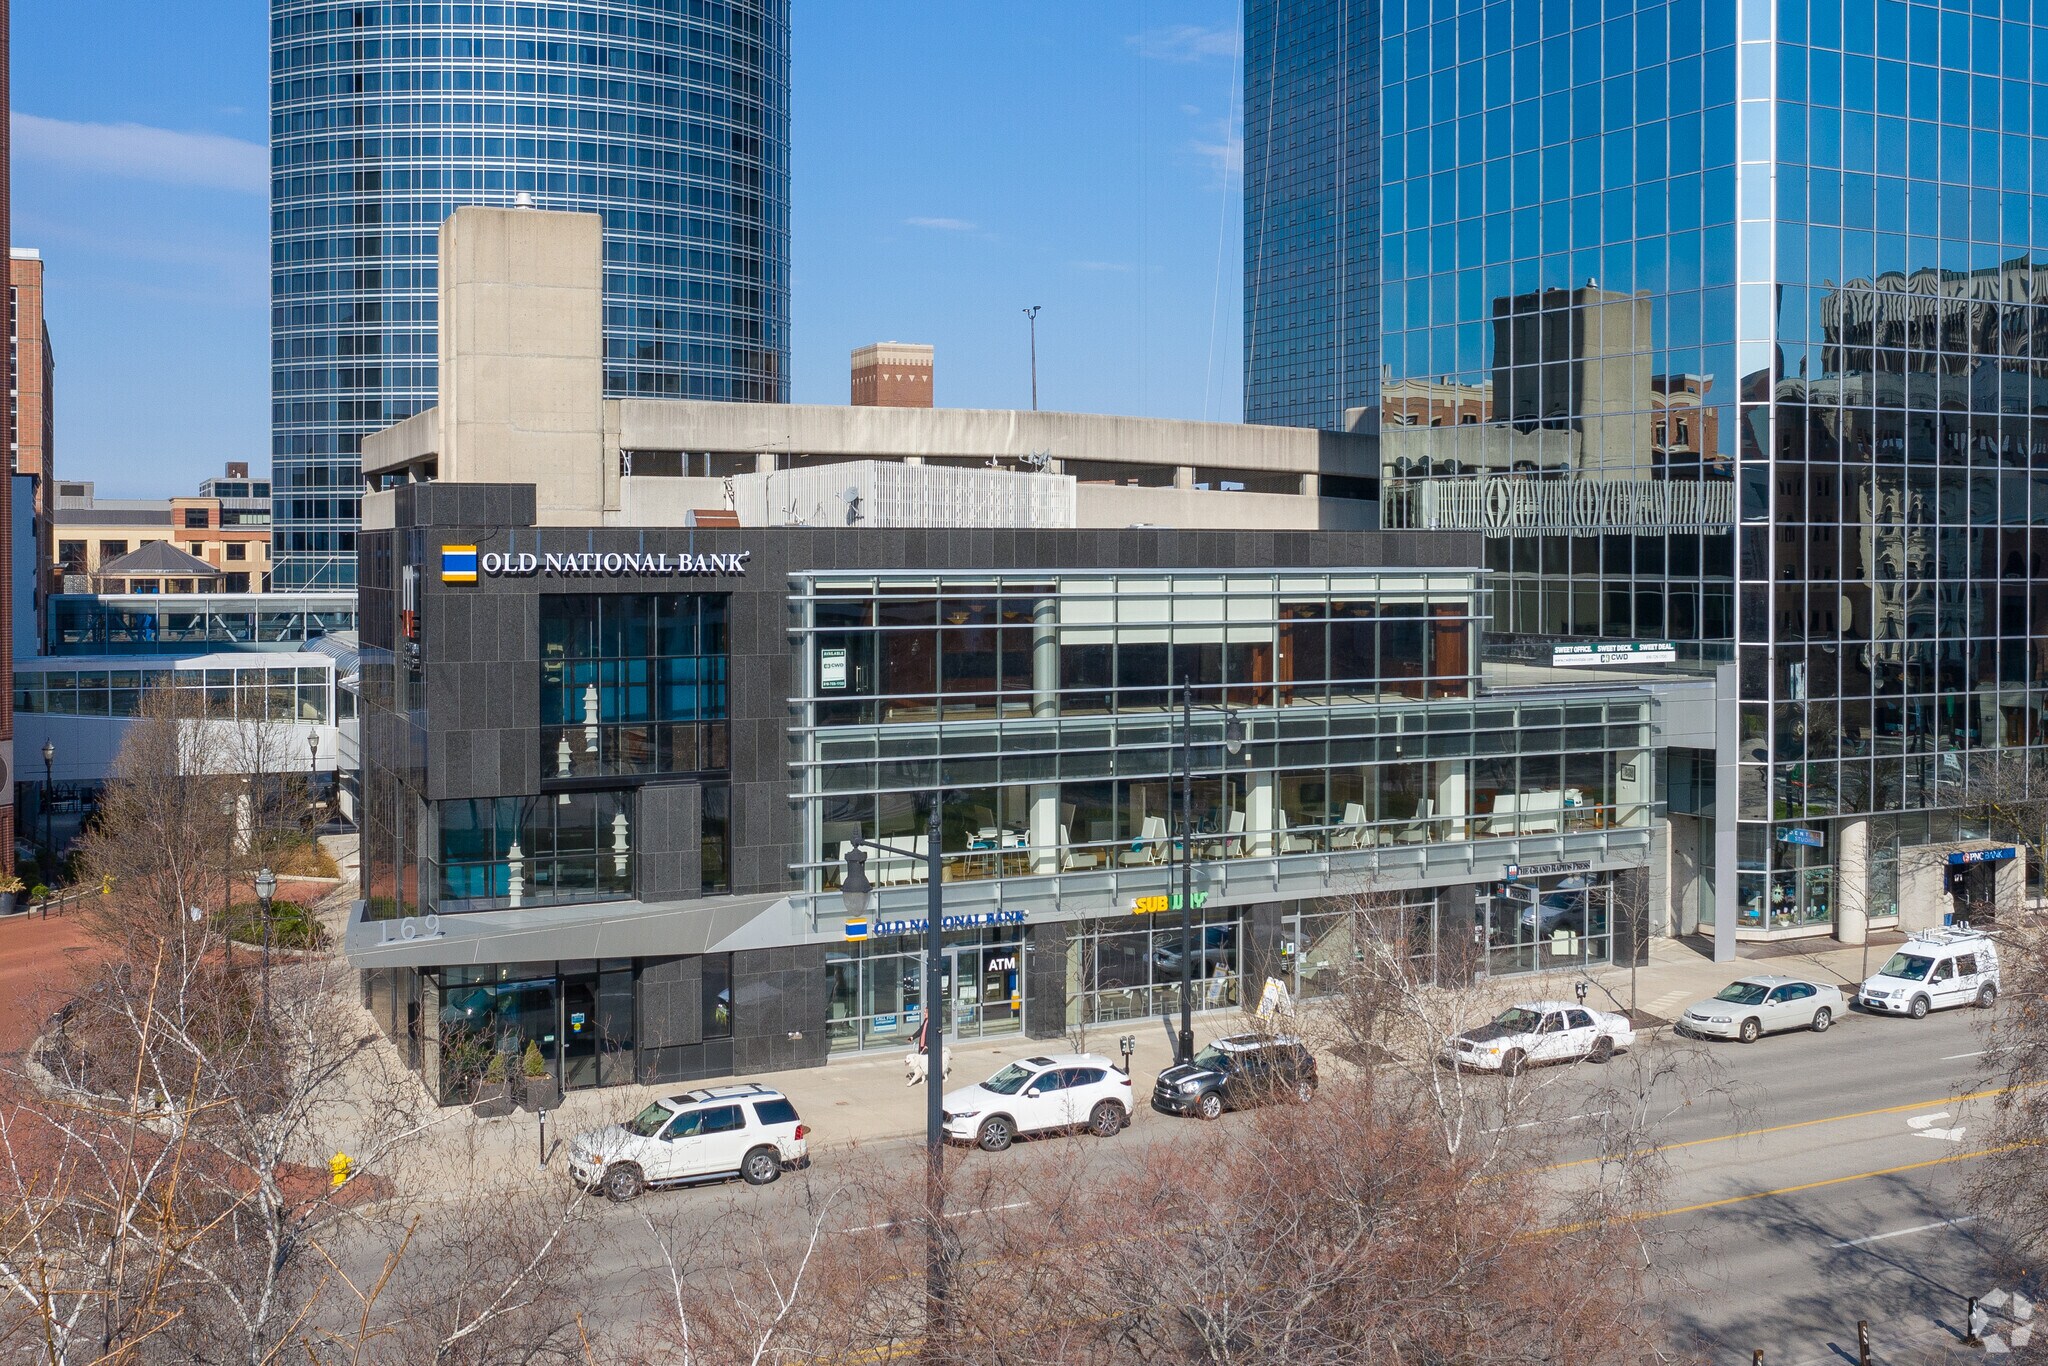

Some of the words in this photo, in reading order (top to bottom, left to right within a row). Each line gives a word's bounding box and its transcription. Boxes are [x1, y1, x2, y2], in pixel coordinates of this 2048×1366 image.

[482, 553, 537, 573] OLD
[544, 553, 672, 573] NATIONAL
[678, 552, 746, 572] BANK
[1554, 646, 1573, 654] SWEET
[1597, 644, 1616, 652] SWEET
[1639, 643, 1657, 651] SWEET
[1611, 653, 1628, 661] CWD
[1970, 852, 1984, 861] PNC
[1984, 850, 2003, 860] BANK
[1519, 867, 1529, 876] THE
[1530, 864, 1551, 875] GRAND
[1551, 863, 1573, 873] RAPIDS
[1573, 861, 1591, 871] PRESS
[379, 914, 440, 942] 169
[874, 919, 906, 936] OLD
[910, 914, 981, 933] NAONAL
[986, 909, 1026, 925] BANK
[988, 957, 1016, 972] ATM
